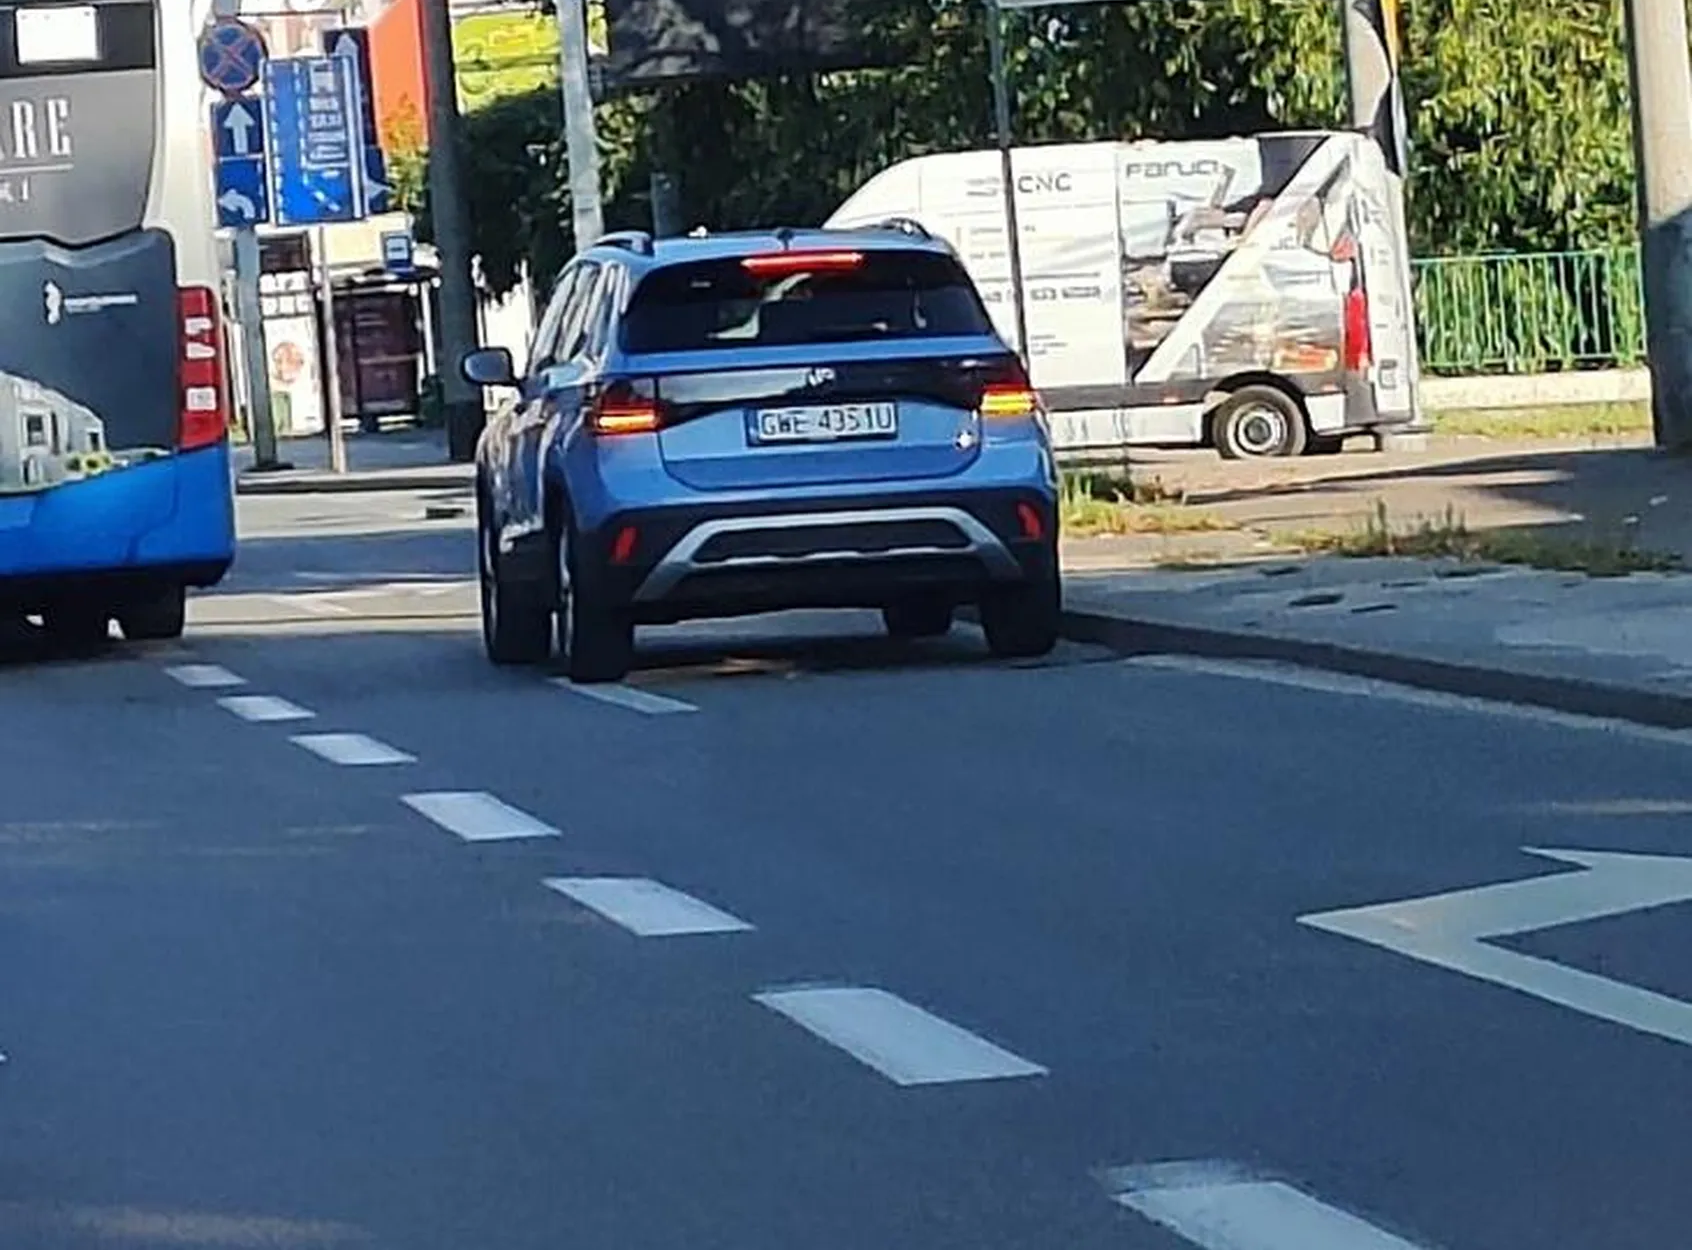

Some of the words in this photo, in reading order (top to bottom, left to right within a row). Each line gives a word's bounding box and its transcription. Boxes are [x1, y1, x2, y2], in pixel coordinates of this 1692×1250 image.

[0, 98, 71, 158] RE
[1017, 173, 1072, 193] CNC
[761, 409, 809, 436] GWE
[818, 405, 893, 432] 4351U
